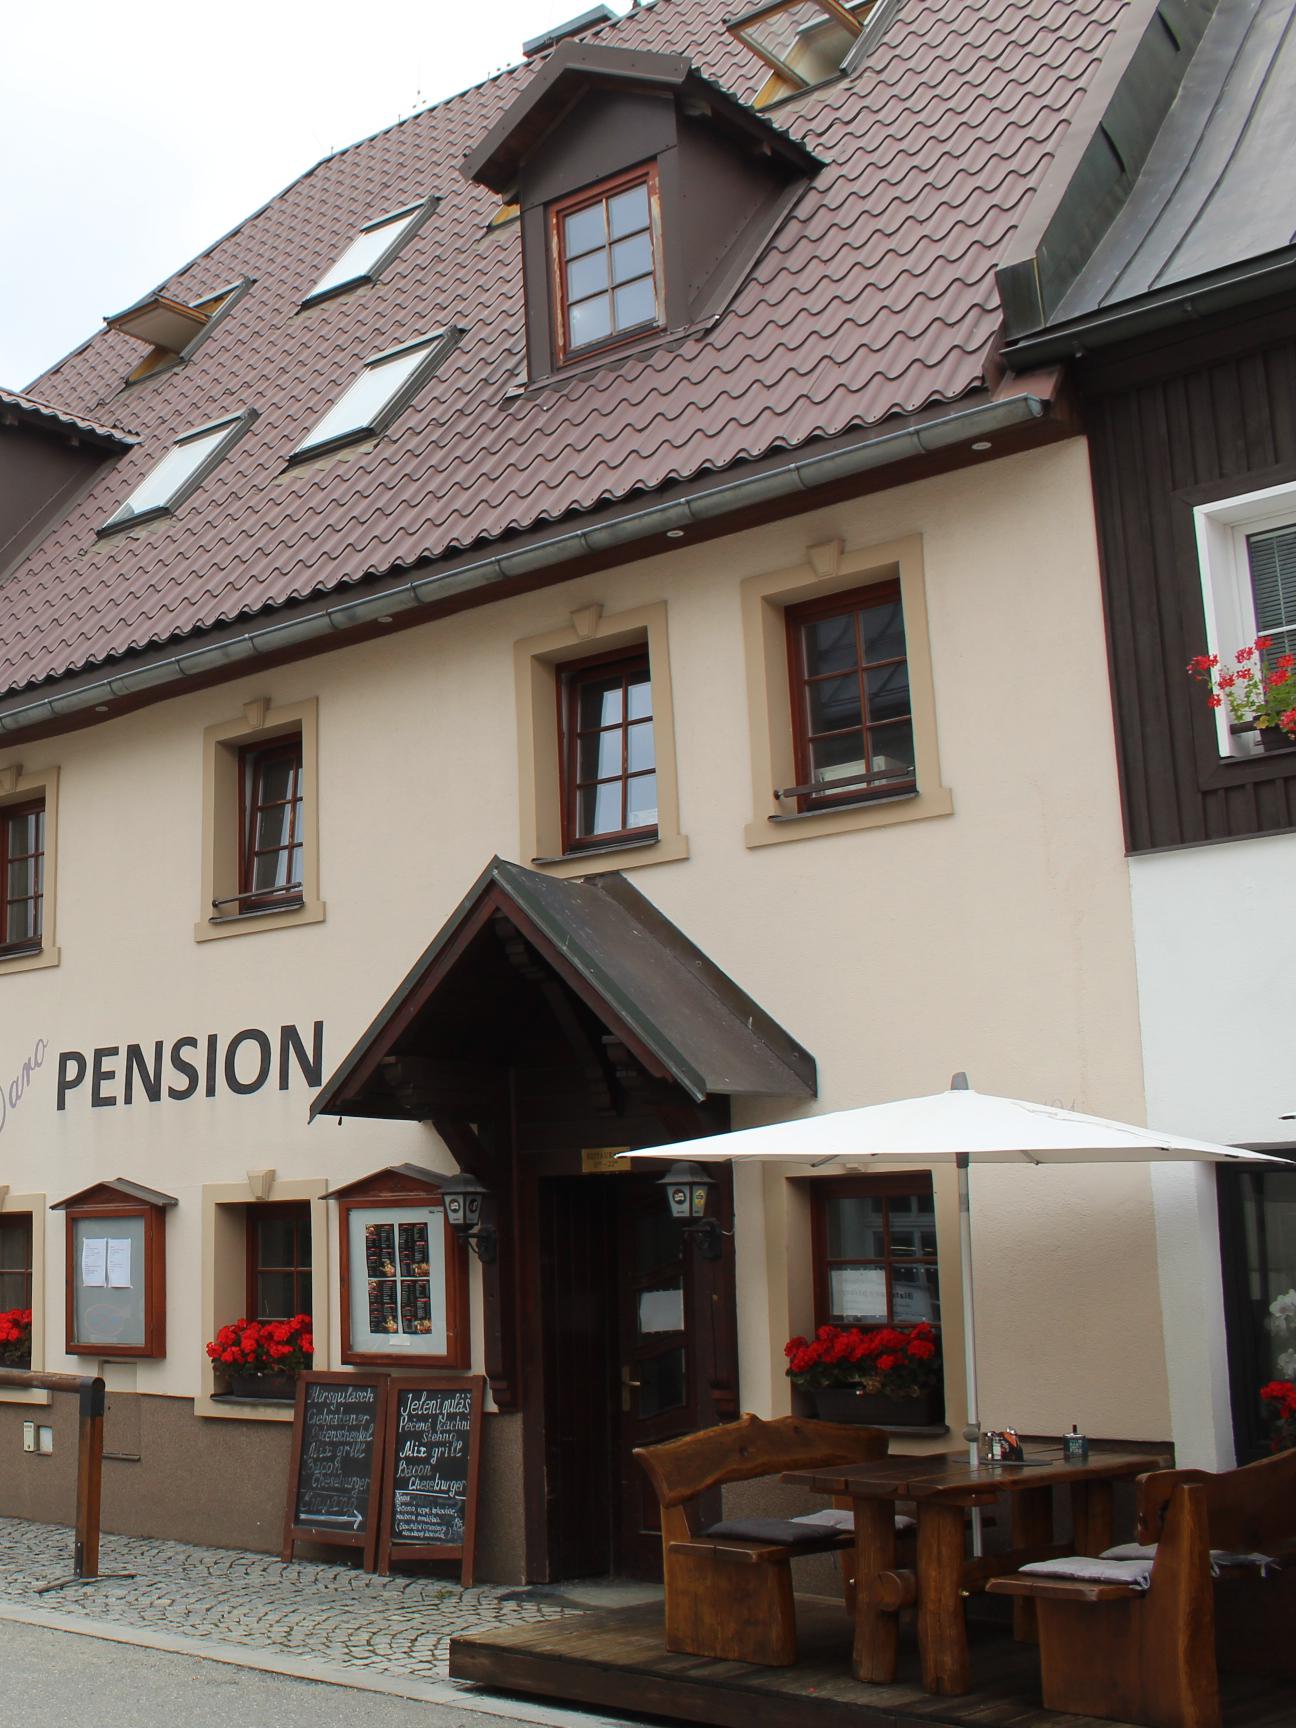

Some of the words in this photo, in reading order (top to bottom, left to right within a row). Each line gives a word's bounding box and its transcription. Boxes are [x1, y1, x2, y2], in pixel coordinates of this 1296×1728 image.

[56, 1020, 324, 1111] PENSION
[399, 1439, 427, 1457] Mix
[430, 1440, 463, 1464] grill
[396, 1460, 432, 1478] Bacon
